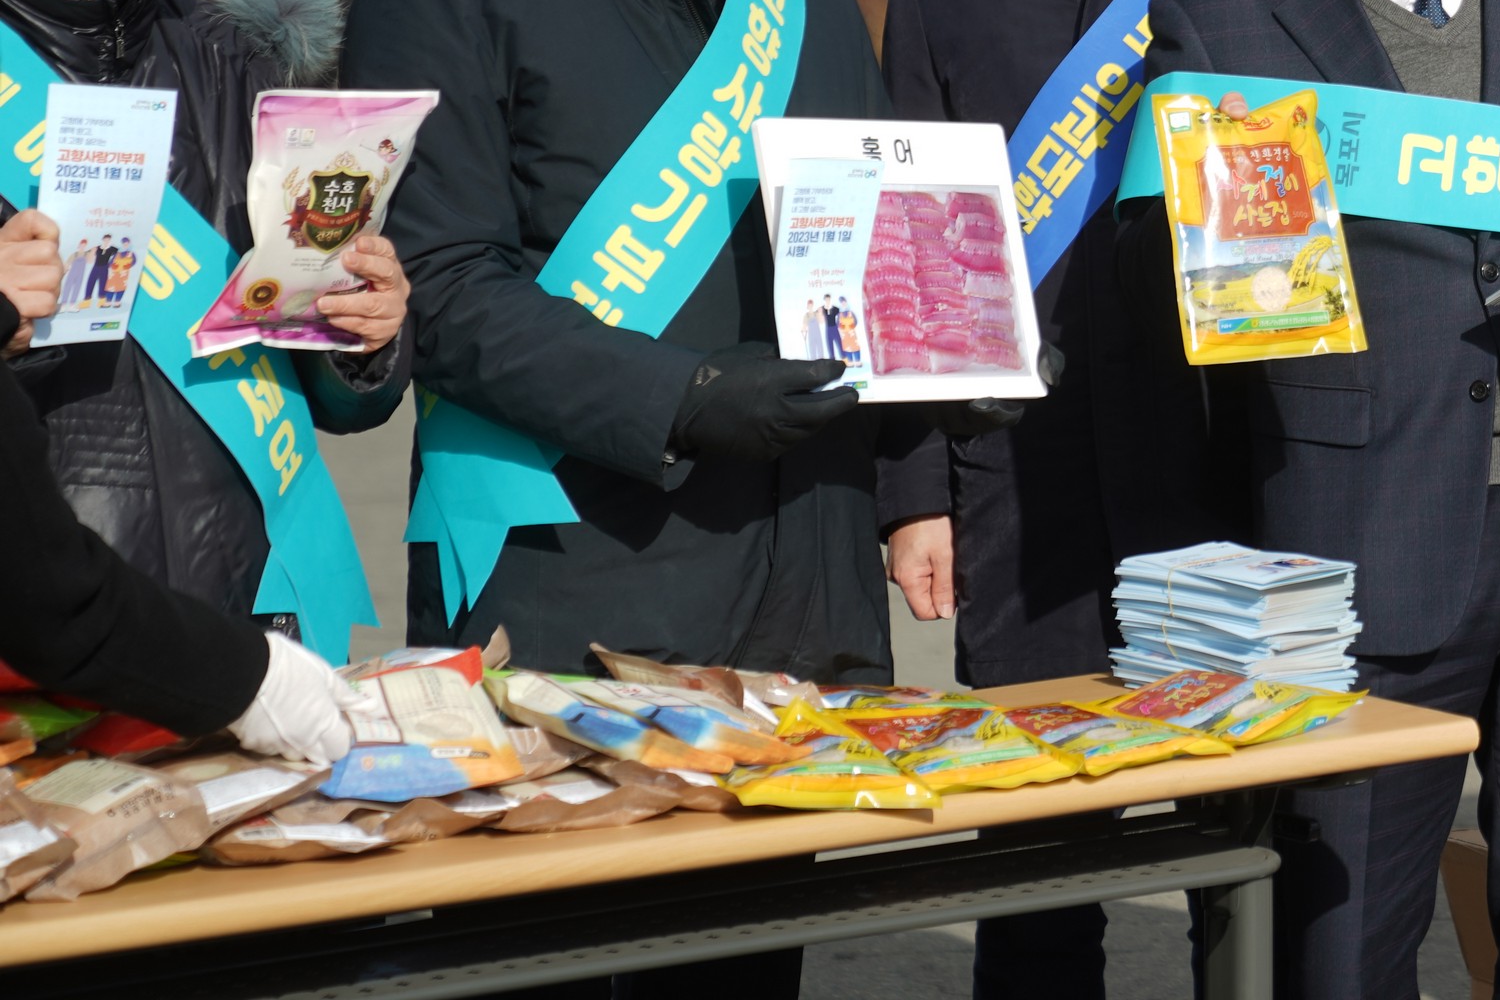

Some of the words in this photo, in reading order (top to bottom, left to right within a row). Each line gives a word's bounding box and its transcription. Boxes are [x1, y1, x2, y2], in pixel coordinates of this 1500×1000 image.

[57, 149, 145, 165] 고향사랑기부제
[1335, 112, 1366, 188] 목포시
[55, 164, 100, 179] 2023년
[104, 167, 121, 180] 1월
[125, 168, 143, 181] 1일
[54, 180, 87, 194] 시행!
[323, 179, 355, 197] 수호
[321, 195, 354, 215] 천사
[789, 217, 855, 229] 고향사랑기부제
[1233, 202, 1290, 228] 사는집
[787, 231, 819, 243] 2023년
[822, 231, 836, 243] 1월
[838, 231, 852, 243] 1일
[786, 245, 809, 257] 시행!
